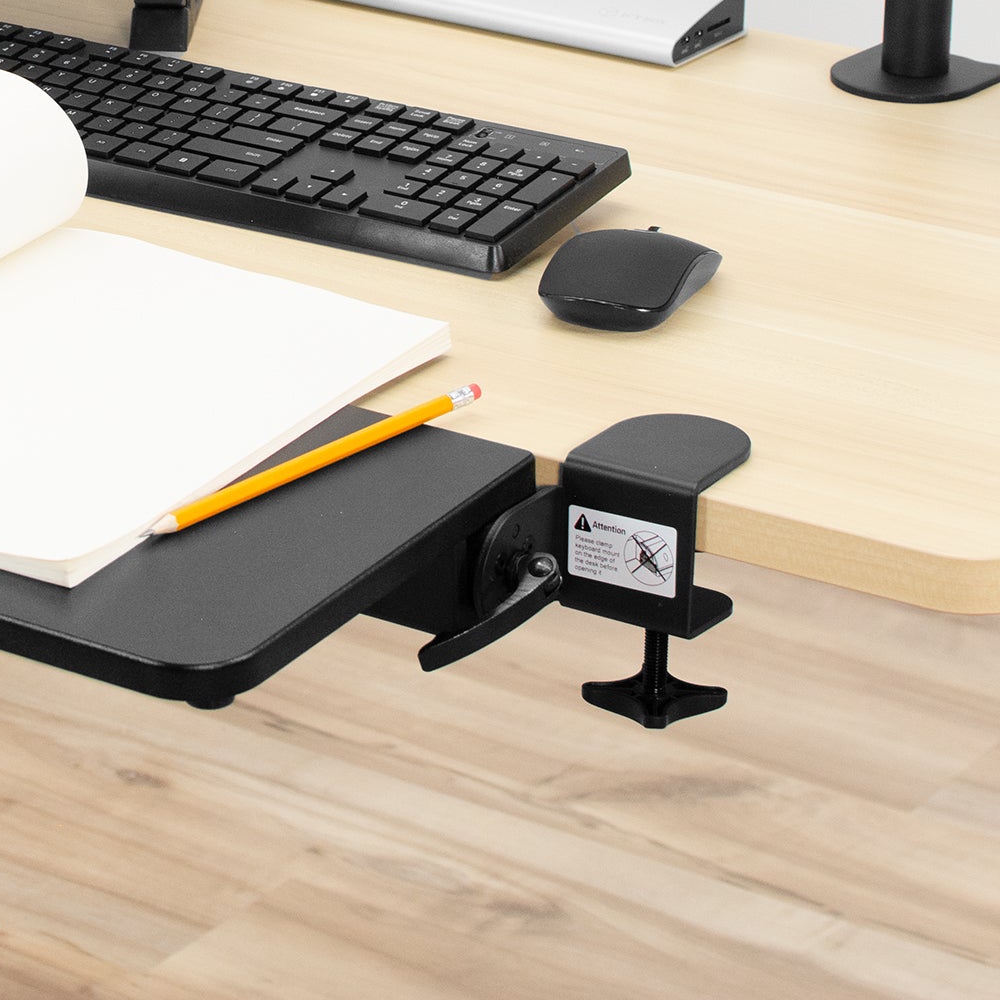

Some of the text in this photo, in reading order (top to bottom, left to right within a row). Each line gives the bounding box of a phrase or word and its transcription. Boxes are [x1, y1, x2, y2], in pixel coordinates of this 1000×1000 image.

[294, 107, 325, 115] Backspace
[592, 521, 626, 535] Attention
[575, 535, 613, 549] Please clamp
[575, 543, 620, 557] keyboard mount
[594, 554, 608, 563] edge
[575, 565, 597, 575] opening
[600, 562, 618, 571] before
